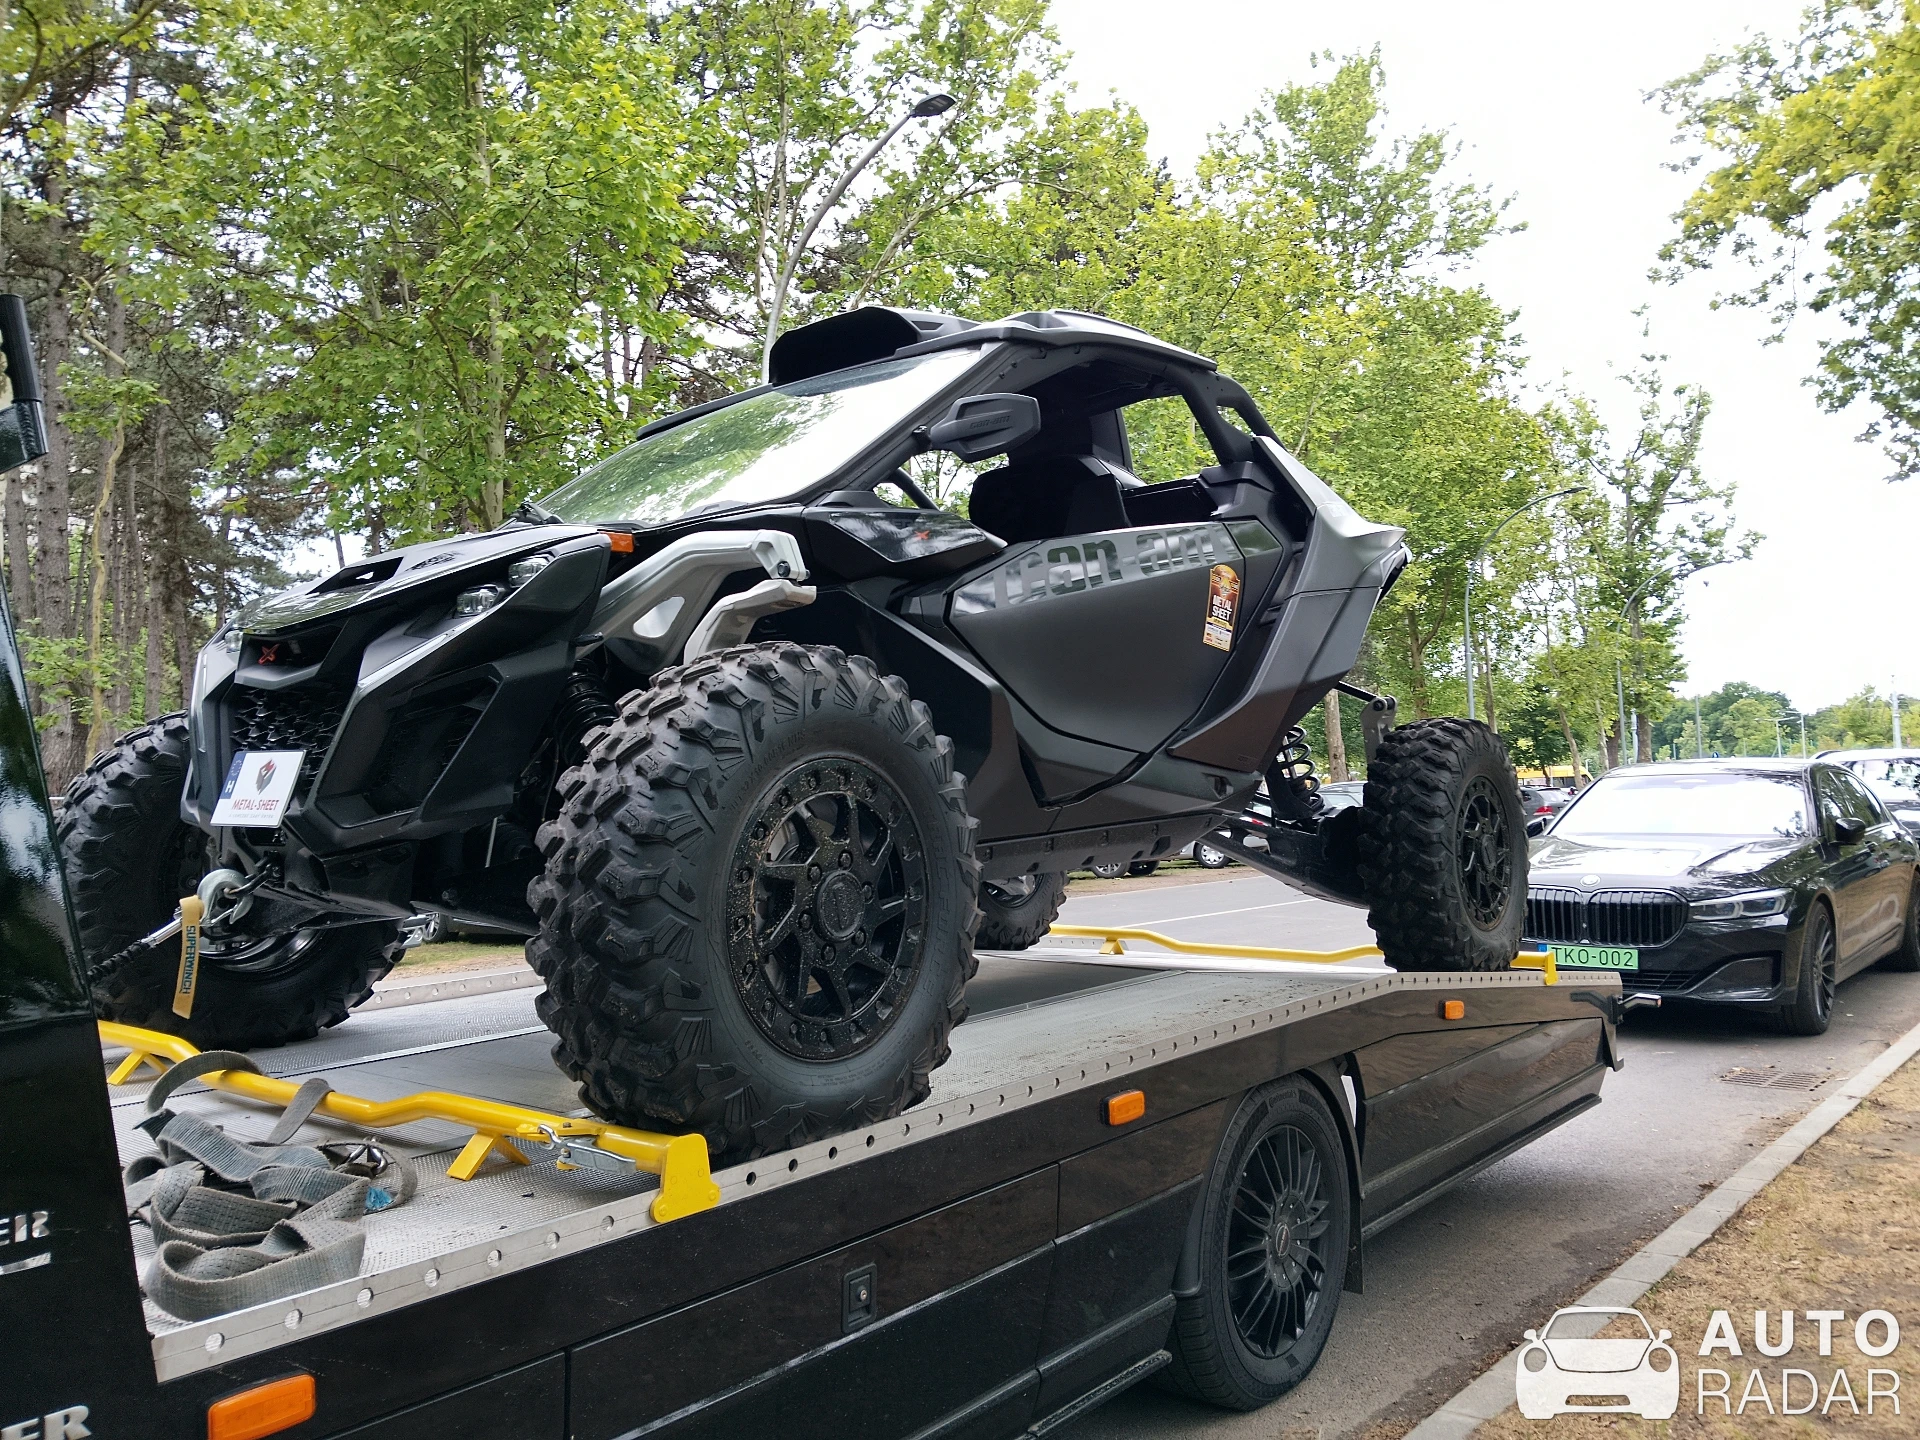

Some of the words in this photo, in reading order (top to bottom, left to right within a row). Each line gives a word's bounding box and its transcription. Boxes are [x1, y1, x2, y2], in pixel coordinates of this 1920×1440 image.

[1212, 595, 1233, 612] METAL
[1211, 605, 1232, 621] SHEET
[224, 780, 236, 793] H
[231, 799, 280, 811] METAL-SHEET
[182, 925, 196, 995] SUPERWINCH
[1551, 947, 1634, 967] TKO-002
